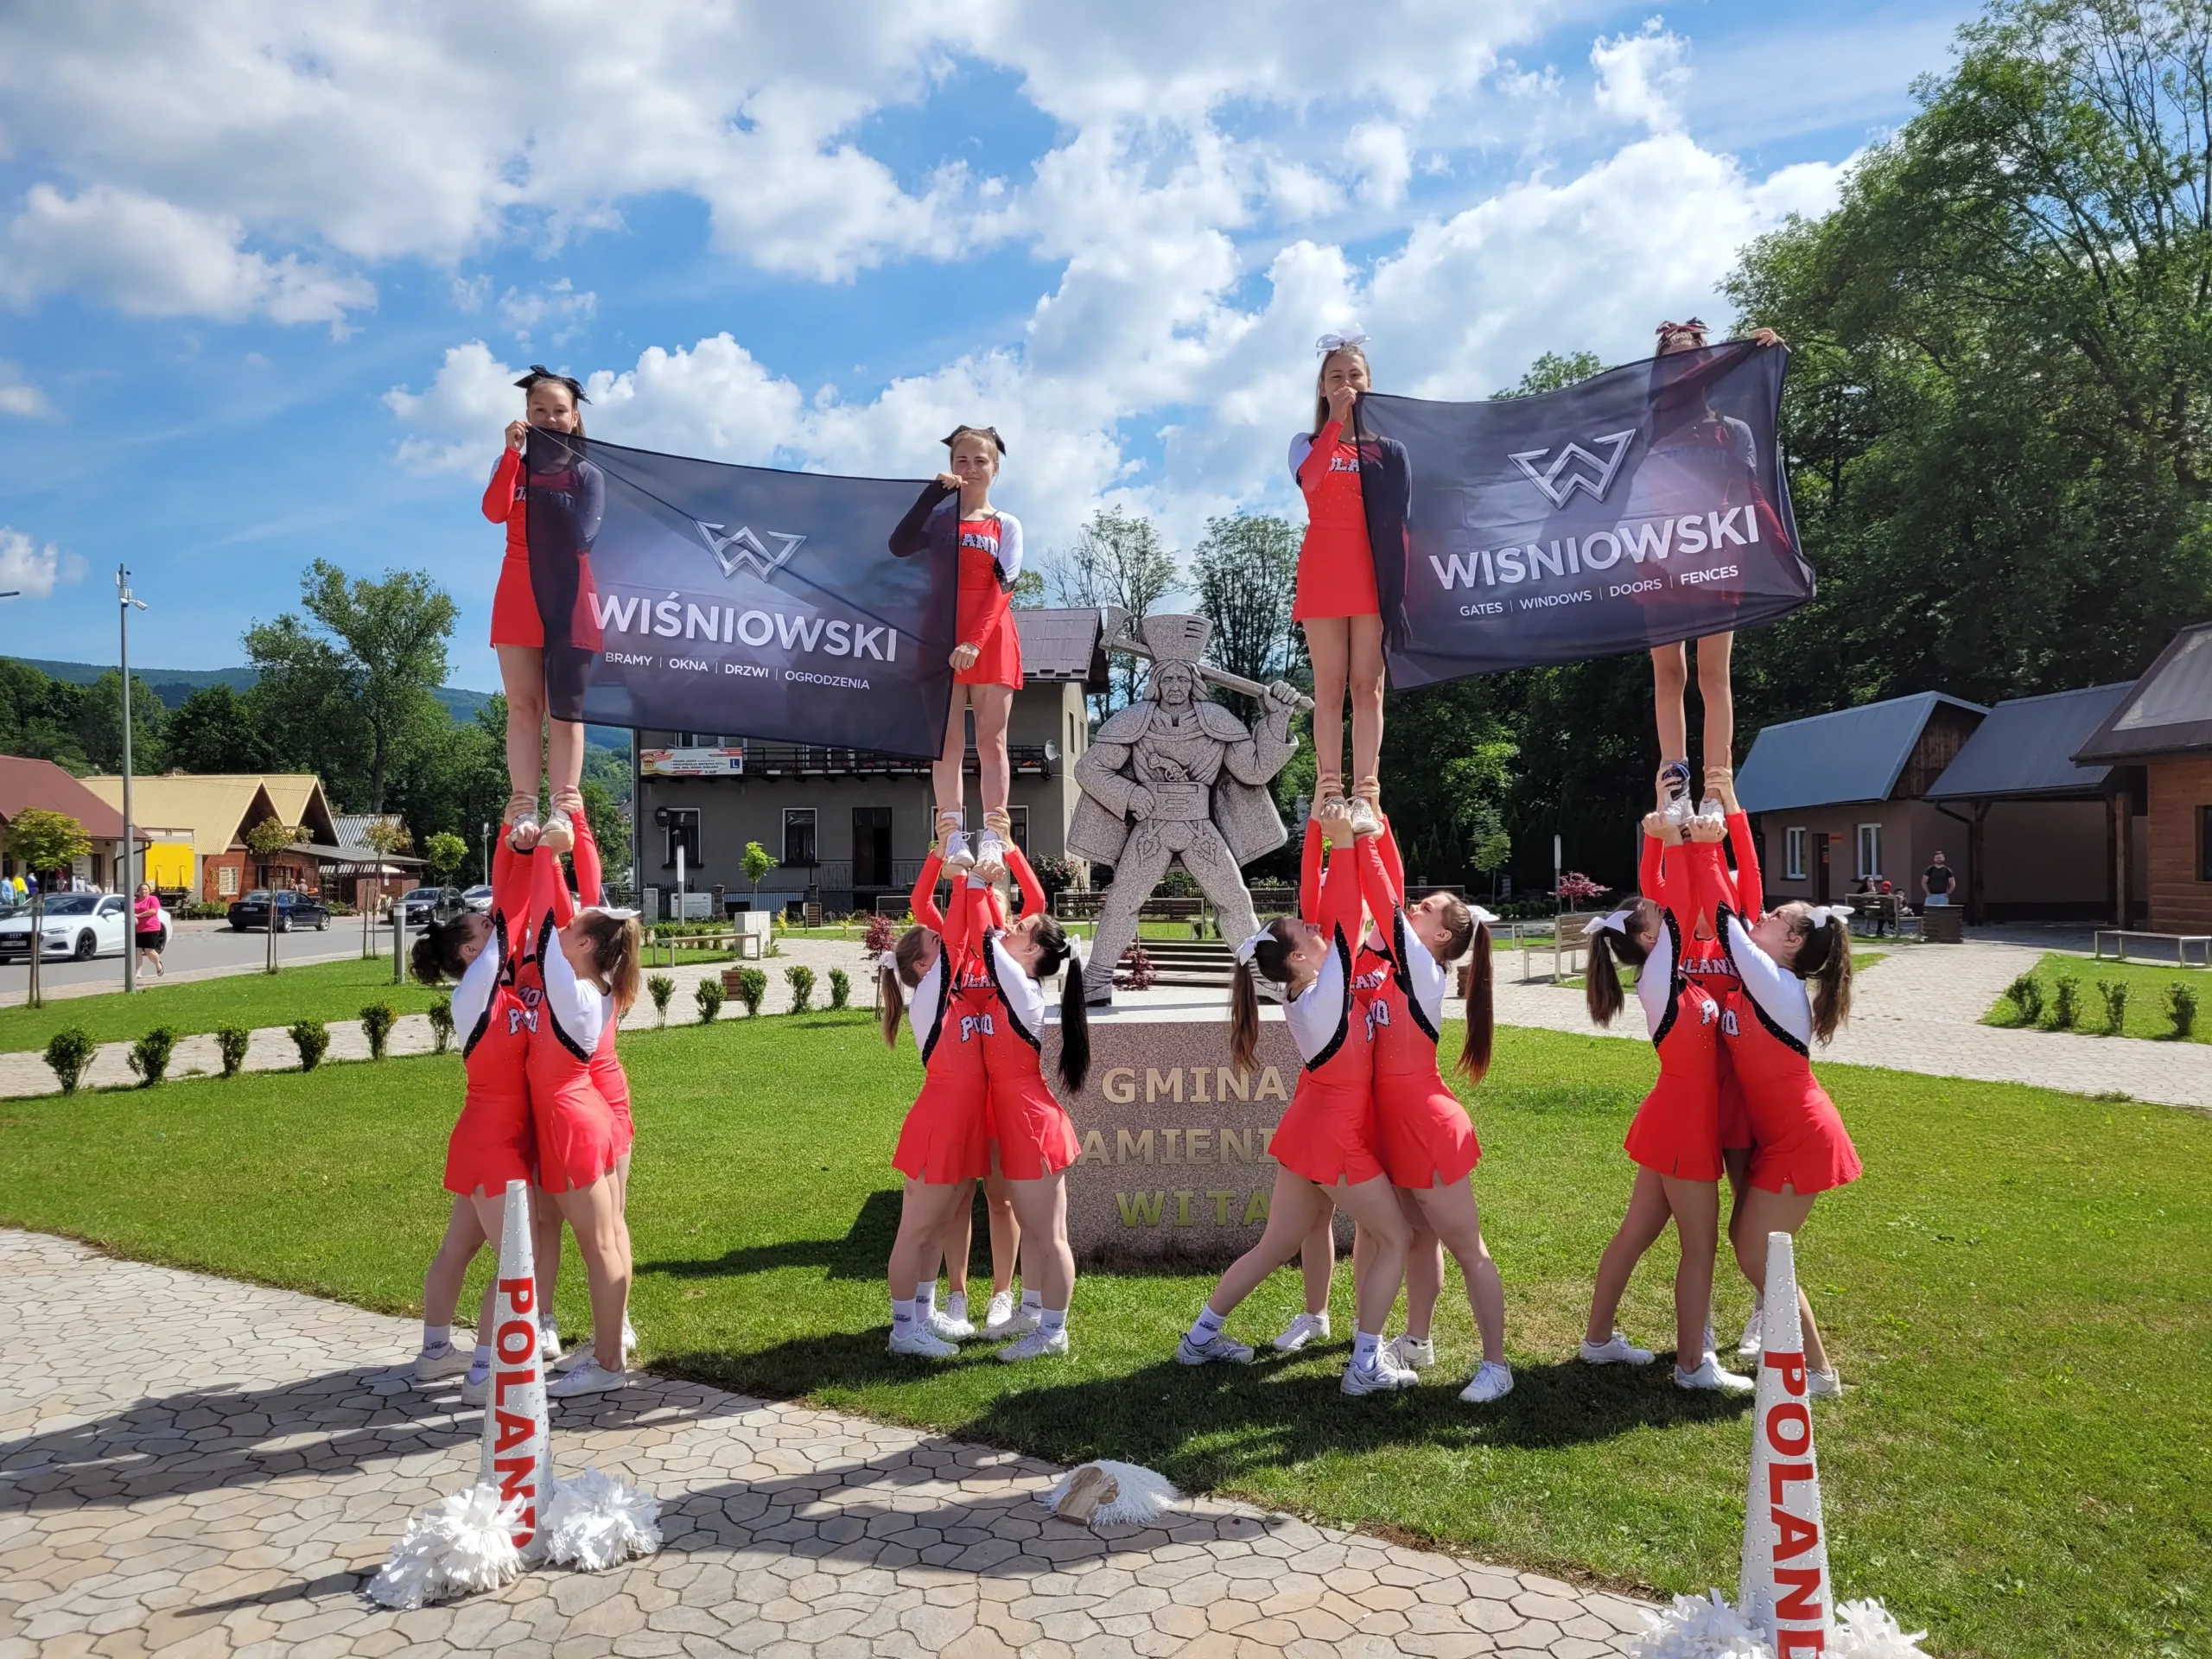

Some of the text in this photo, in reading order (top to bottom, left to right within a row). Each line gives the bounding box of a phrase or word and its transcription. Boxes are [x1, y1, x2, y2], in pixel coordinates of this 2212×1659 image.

[1429, 505, 1760, 592] WISNIOWSKI
[1459, 564, 1738, 617] GATES WINDOWS DOORS FENCES
[588, 591, 898, 662] WIŚNIOWSKI
[606, 652, 870, 690] BRAMY OKNA DRZWI OGRODZENIA
[1102, 1066, 1288, 1103] GMINA
[1077, 1129, 1277, 1165] AMIENI
[1116, 1190, 1270, 1228] WITA
